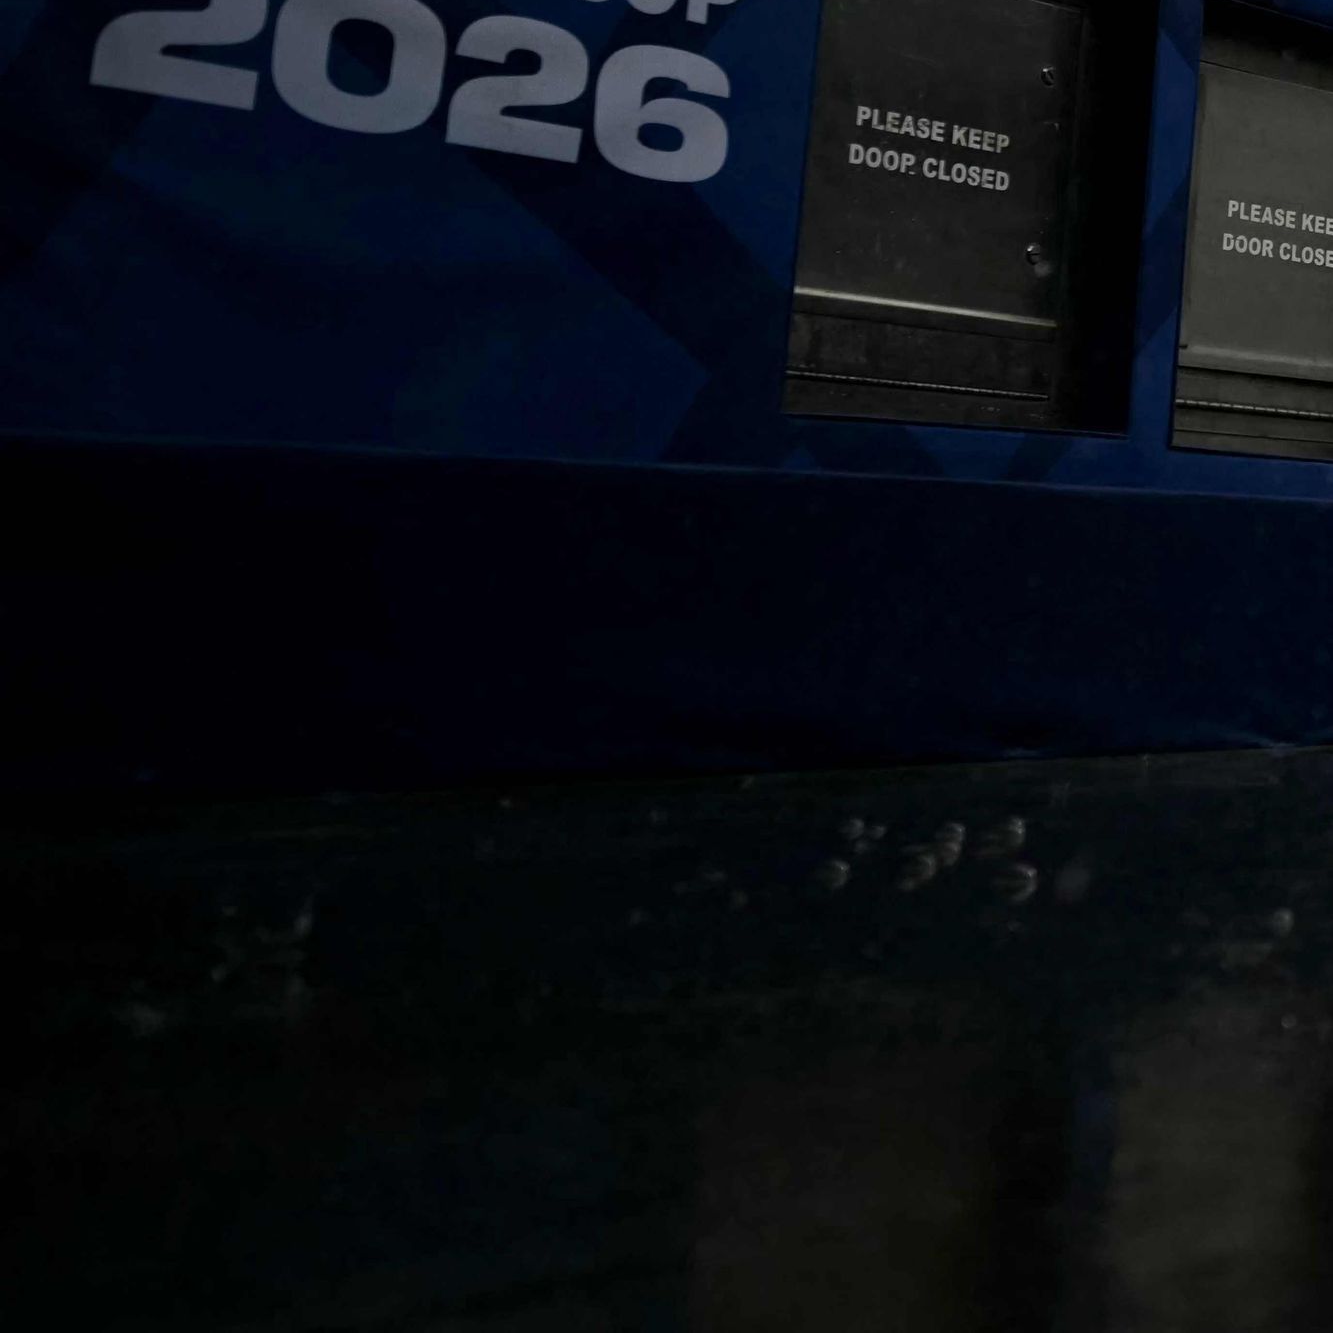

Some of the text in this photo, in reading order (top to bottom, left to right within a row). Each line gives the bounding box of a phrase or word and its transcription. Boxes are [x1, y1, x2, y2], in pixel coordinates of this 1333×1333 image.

[856, 105, 1010, 153] PLEASE KEEP
[922, 157, 1010, 191] CLOSED
[1227, 199, 1296, 229] PLEASE
[1222, 232, 1274, 258] DOOR
